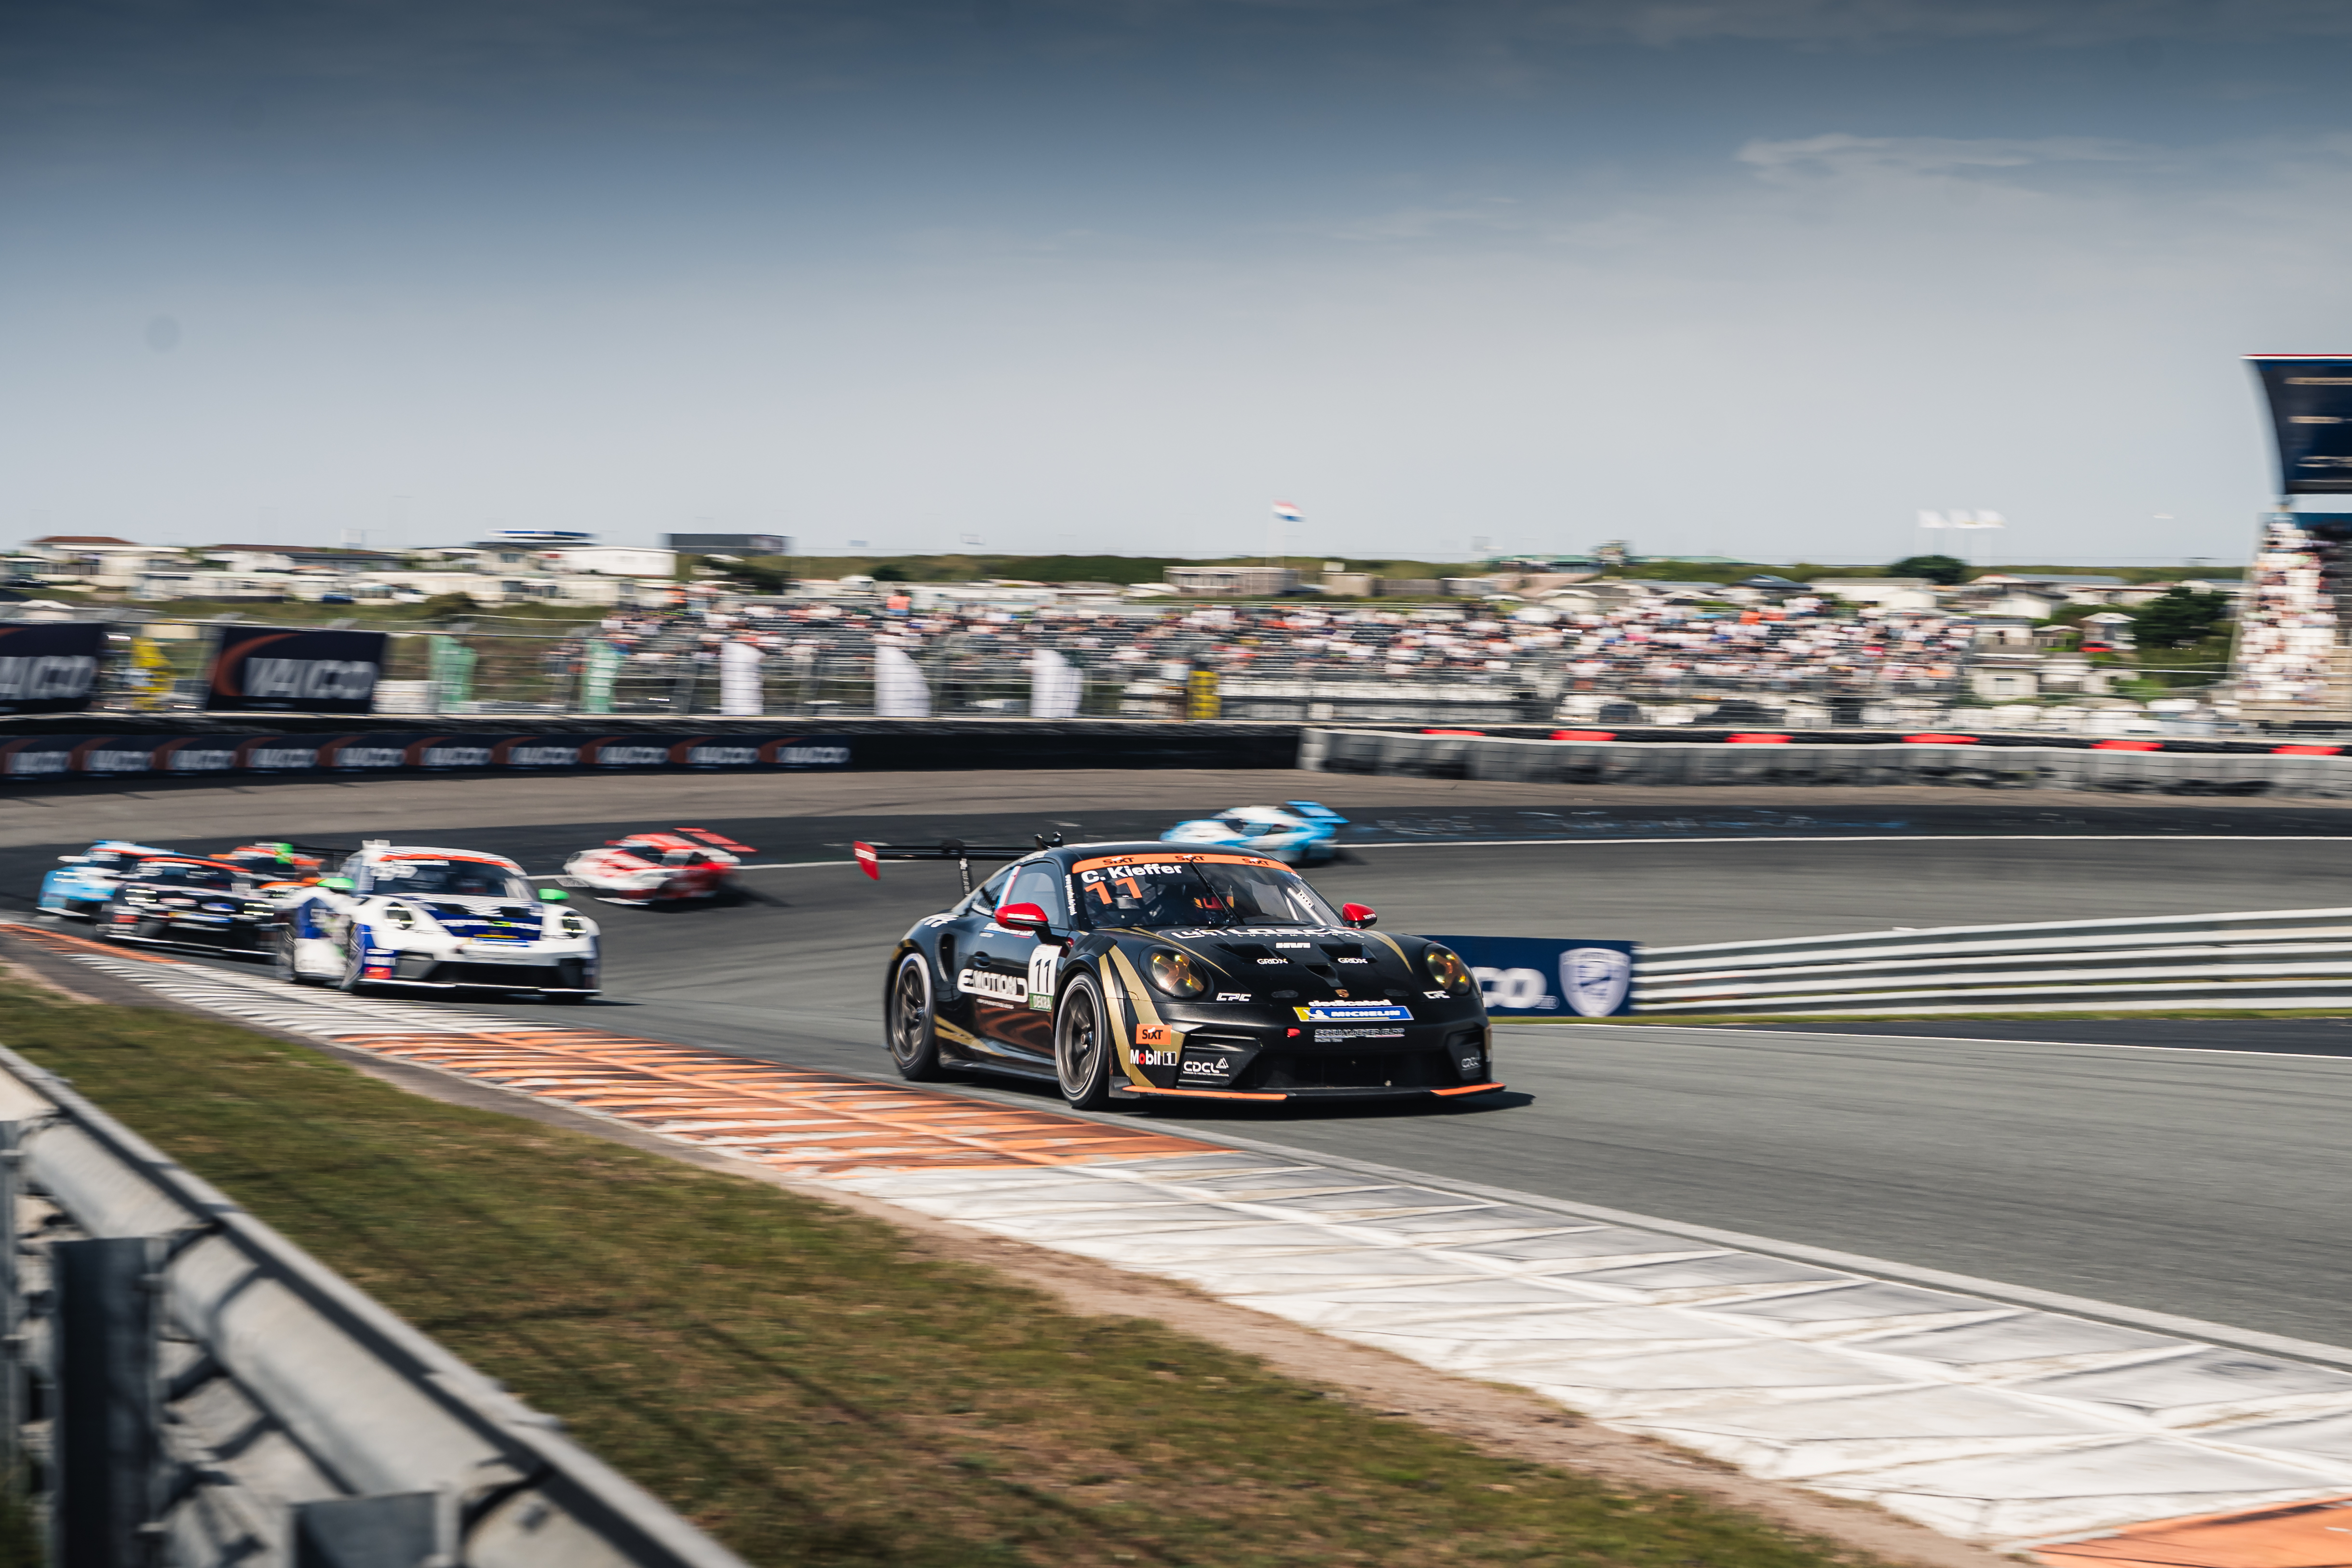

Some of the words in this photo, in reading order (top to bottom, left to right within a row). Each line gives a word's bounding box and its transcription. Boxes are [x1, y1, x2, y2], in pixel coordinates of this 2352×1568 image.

[1081, 870, 1106, 883] C.
[1107, 864, 1182, 879] Kieffer
[1085, 877, 1142, 905] 11
[1035, 959, 1051, 993] 11
[1130, 1049, 1161, 1065] Mobil
[1184, 1061, 1220, 1073] CDCL
